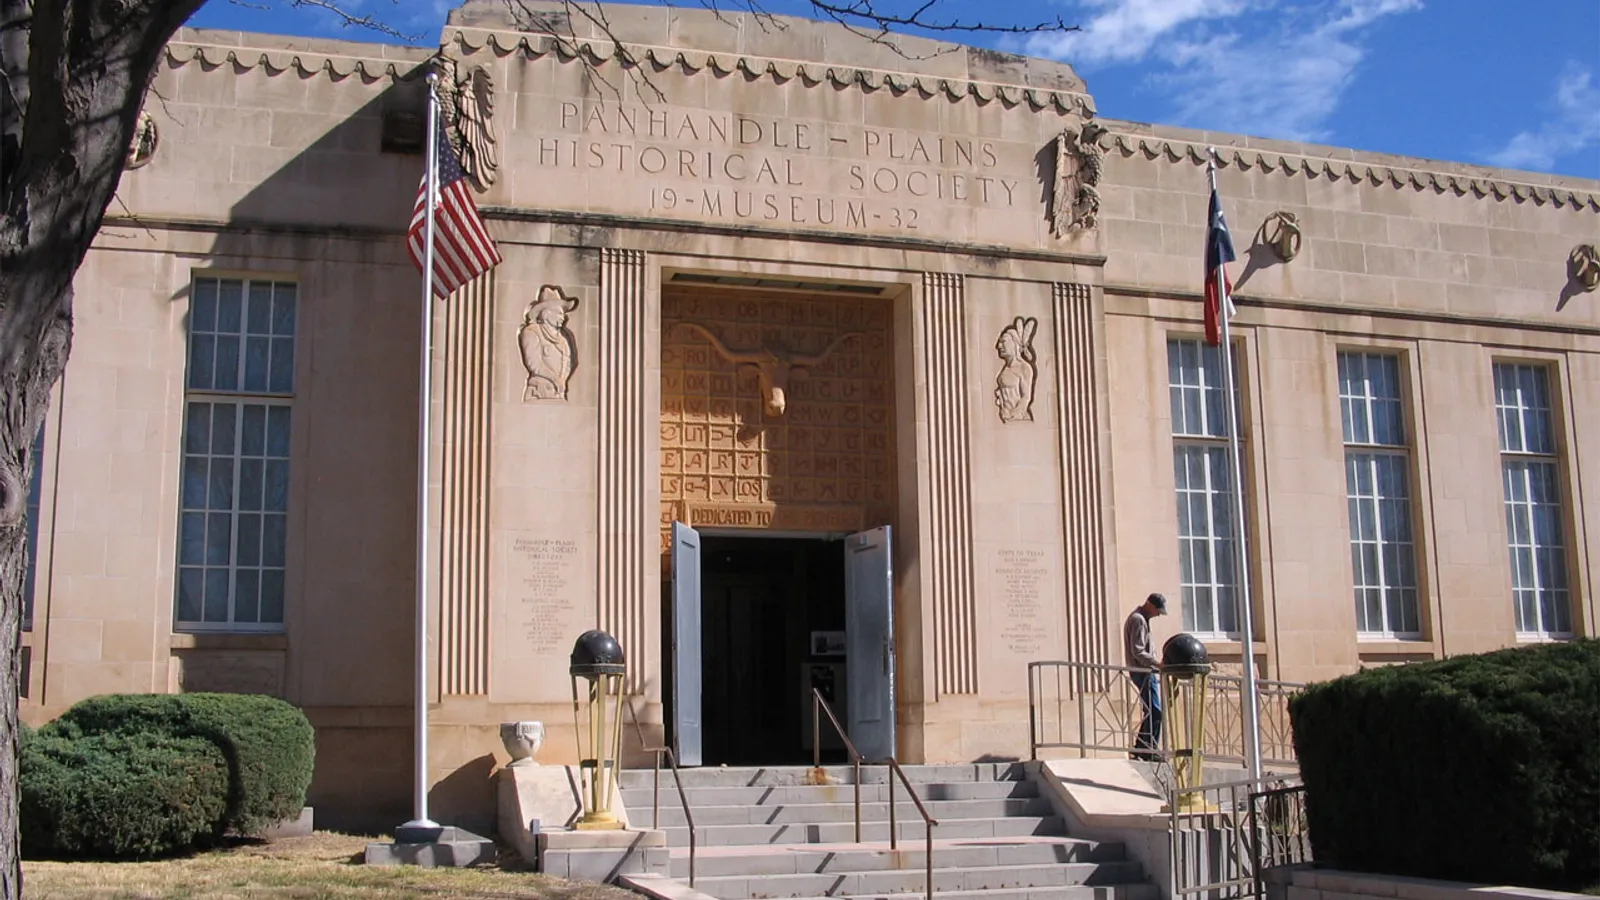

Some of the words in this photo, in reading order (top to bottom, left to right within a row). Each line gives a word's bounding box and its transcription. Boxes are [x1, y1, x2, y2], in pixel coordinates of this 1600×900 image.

[559, 101, 812, 151] PANHANDLE
[864, 129, 998, 169] PLAINS
[538, 138, 804, 188] HISTORICAL
[848, 164, 1019, 207] SOCIETY
[692, 508, 752, 525] DEDICATED
[756, 510, 771, 525] TO
